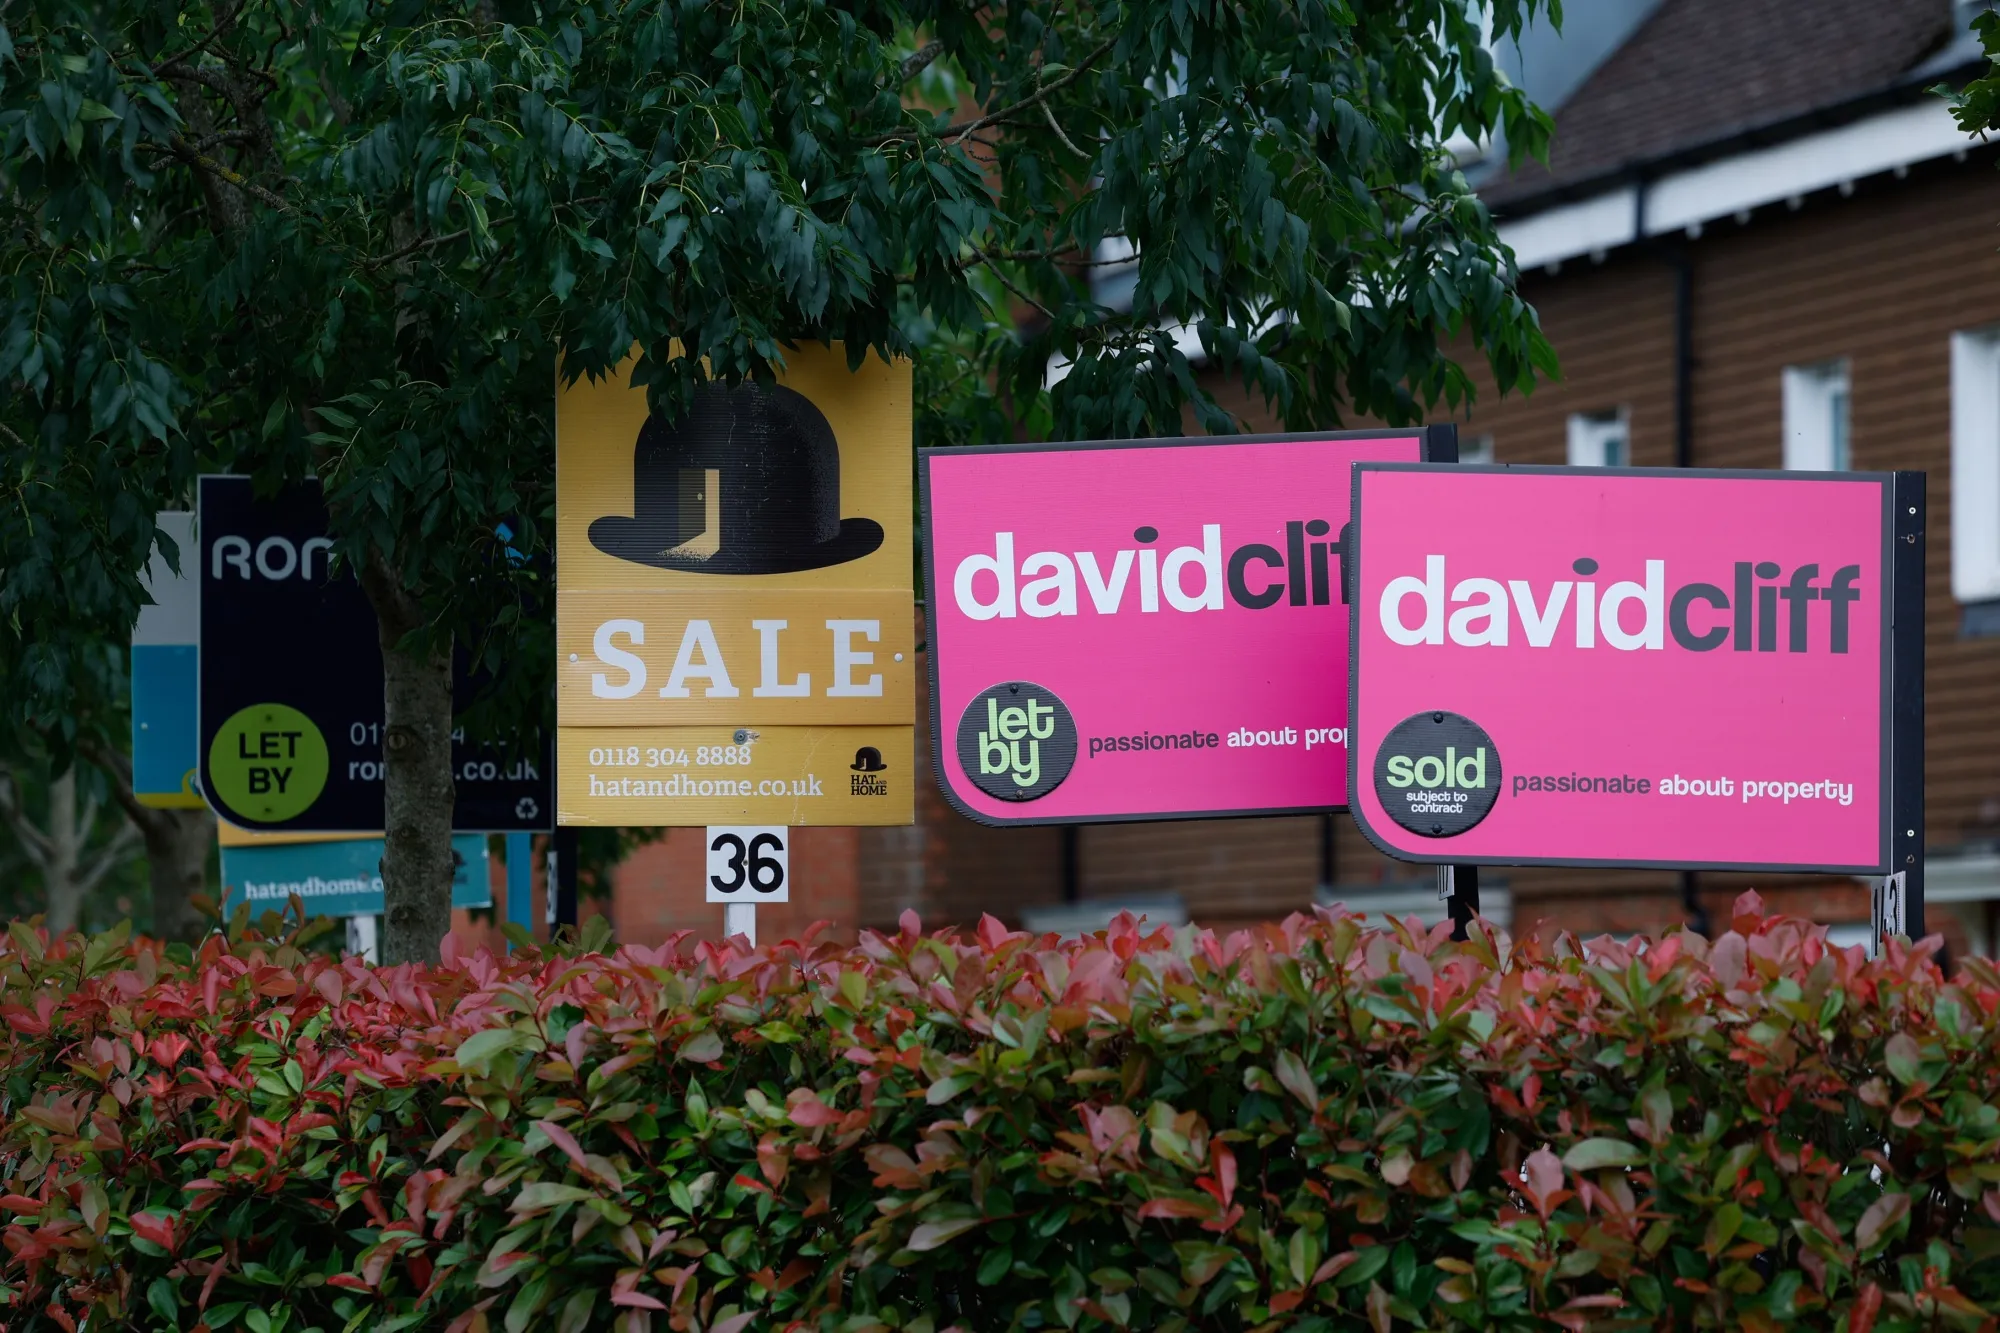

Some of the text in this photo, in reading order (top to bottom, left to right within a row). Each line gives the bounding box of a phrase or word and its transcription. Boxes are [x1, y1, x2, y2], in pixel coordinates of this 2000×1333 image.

[1379, 554, 1860, 654] davidcliff
[591, 618, 883, 699] SALE
[988, 698, 1055, 740] let
[238, 731, 302, 760] LET
[1088, 730, 1220, 758] passionate
[1227, 726, 1298, 748] about
[589, 746, 752, 768] 0118 304 8888
[978, 731, 1041, 787] by
[1386, 747, 1486, 789] sold
[248, 766, 293, 795] BY
[589, 774, 824, 797] hatandhome.co.uk
[850, 774, 877, 785] HAT
[850, 785, 888, 796] HOME
[1512, 772, 1853, 806] passionate about property
[1406, 791, 1468, 804] subject to
[1410, 803, 1463, 813] contract
[710, 833, 785, 894] 36
[244, 876, 385, 900] hatandhome.c
